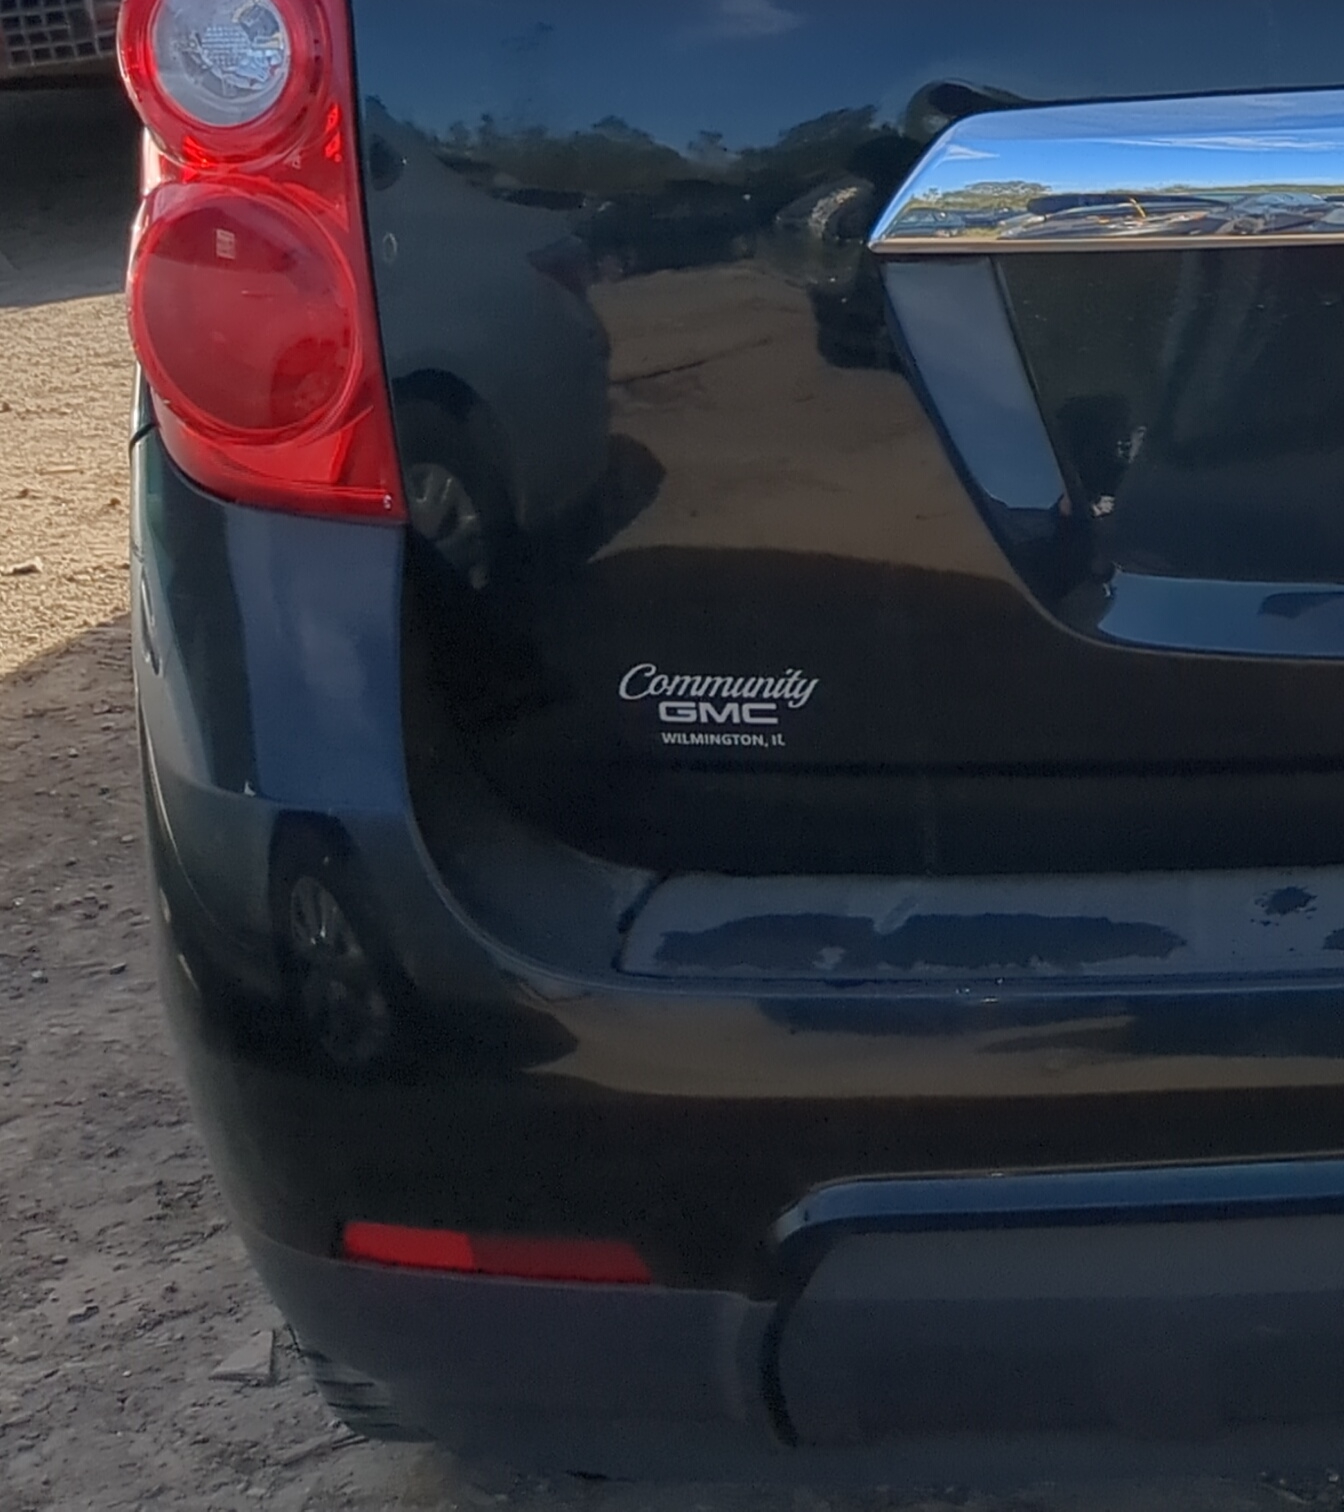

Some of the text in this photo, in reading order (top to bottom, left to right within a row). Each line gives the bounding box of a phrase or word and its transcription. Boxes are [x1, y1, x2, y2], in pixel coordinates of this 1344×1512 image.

[618, 662, 820, 709] Community
[658, 700, 779, 724] GMC
[660, 731, 786, 748] WILMINGTON, IL
